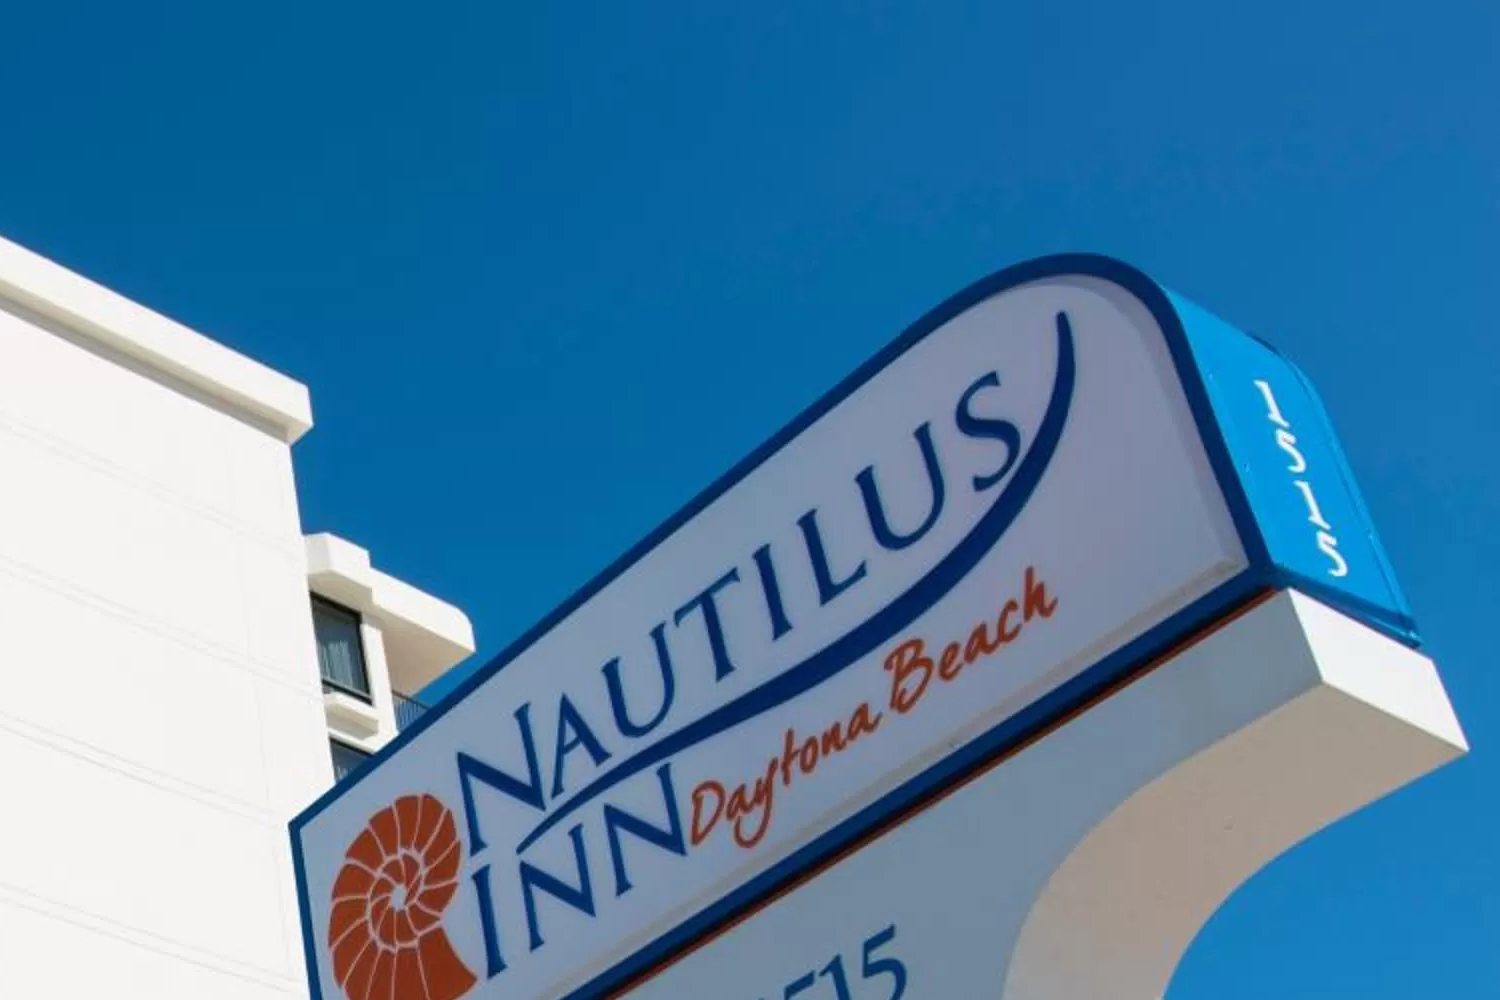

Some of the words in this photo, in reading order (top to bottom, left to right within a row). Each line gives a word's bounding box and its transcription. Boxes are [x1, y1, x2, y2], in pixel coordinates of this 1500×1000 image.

[1253, 379, 1349, 577] 1515
[455, 370, 1022, 858] NAUTILUS
[688, 706, 880, 850] Daytona
[883, 565, 1060, 715] Beach
[472, 761, 689, 981] INN
